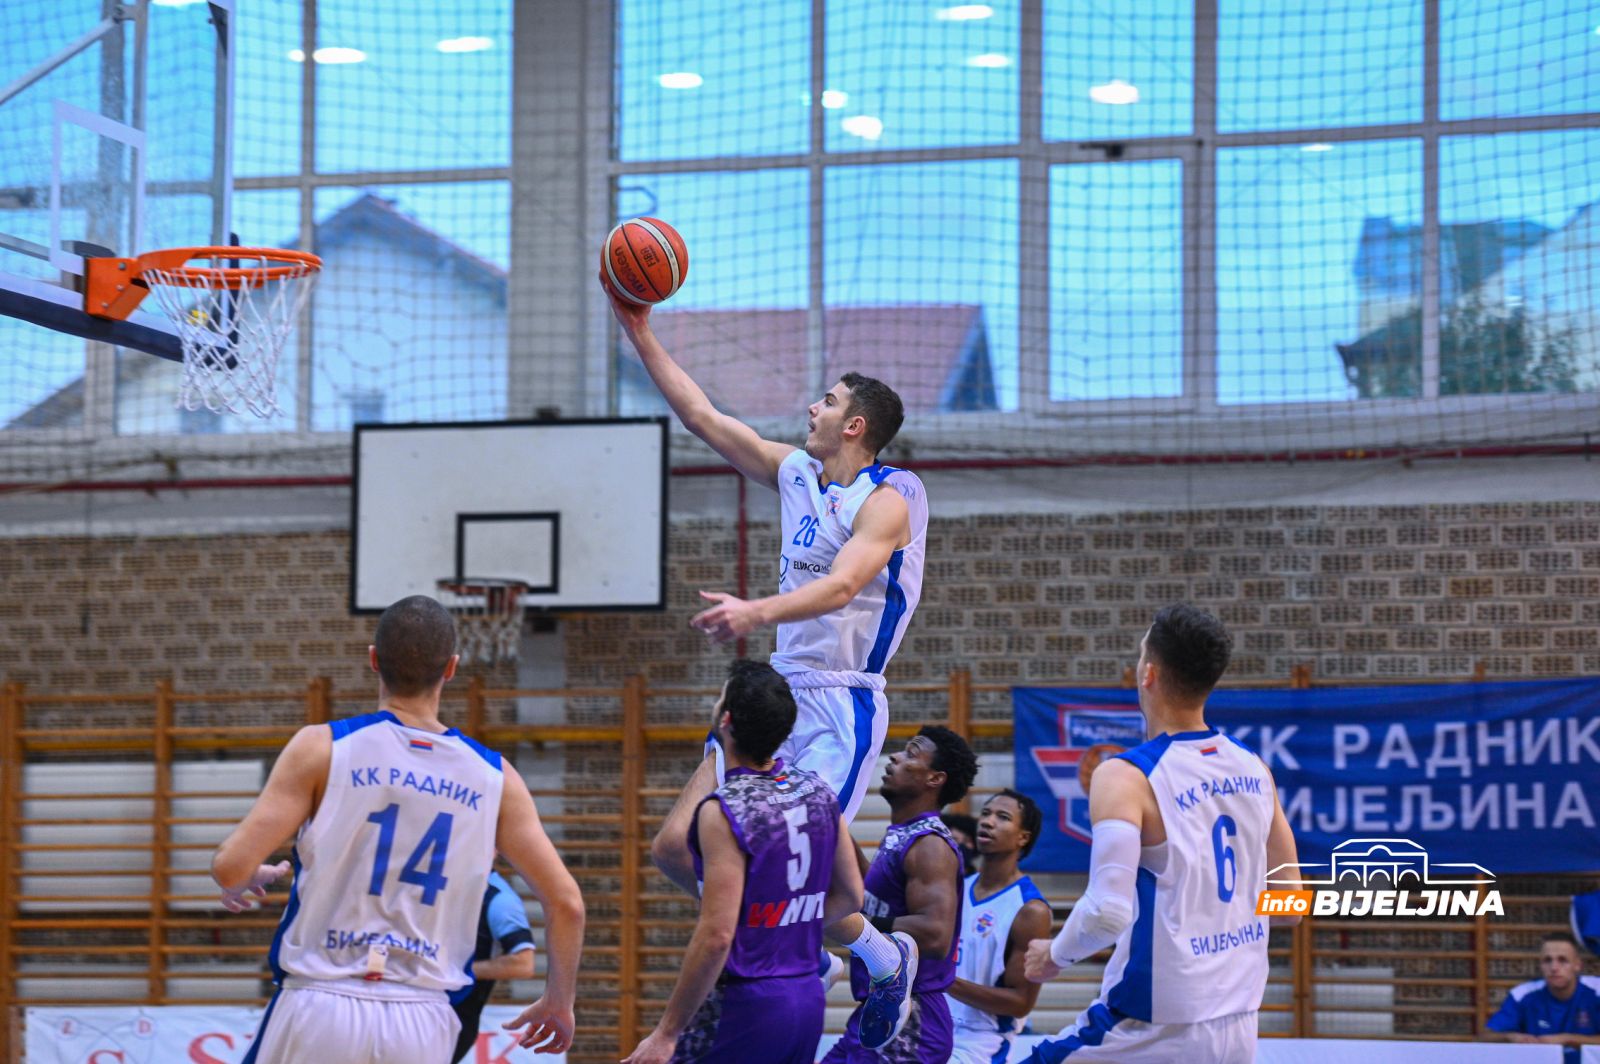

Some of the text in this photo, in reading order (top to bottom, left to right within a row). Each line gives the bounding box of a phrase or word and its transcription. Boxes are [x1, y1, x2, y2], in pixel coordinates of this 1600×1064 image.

[792, 515, 820, 548] 26
[793, 560, 820, 573] ELVACO
[1333, 715, 1600, 778] РАДНИК
[351, 767, 482, 811] КК РАДНИК
[1175, 775, 1262, 812] КК РАДНИК
[1278, 781, 1596, 833] ИЈЕЉИНА
[367, 803, 454, 907] 14
[783, 804, 812, 892] 5
[1212, 815, 1237, 903] 6
[1190, 922, 1265, 955] БИЈЕЉИНА
